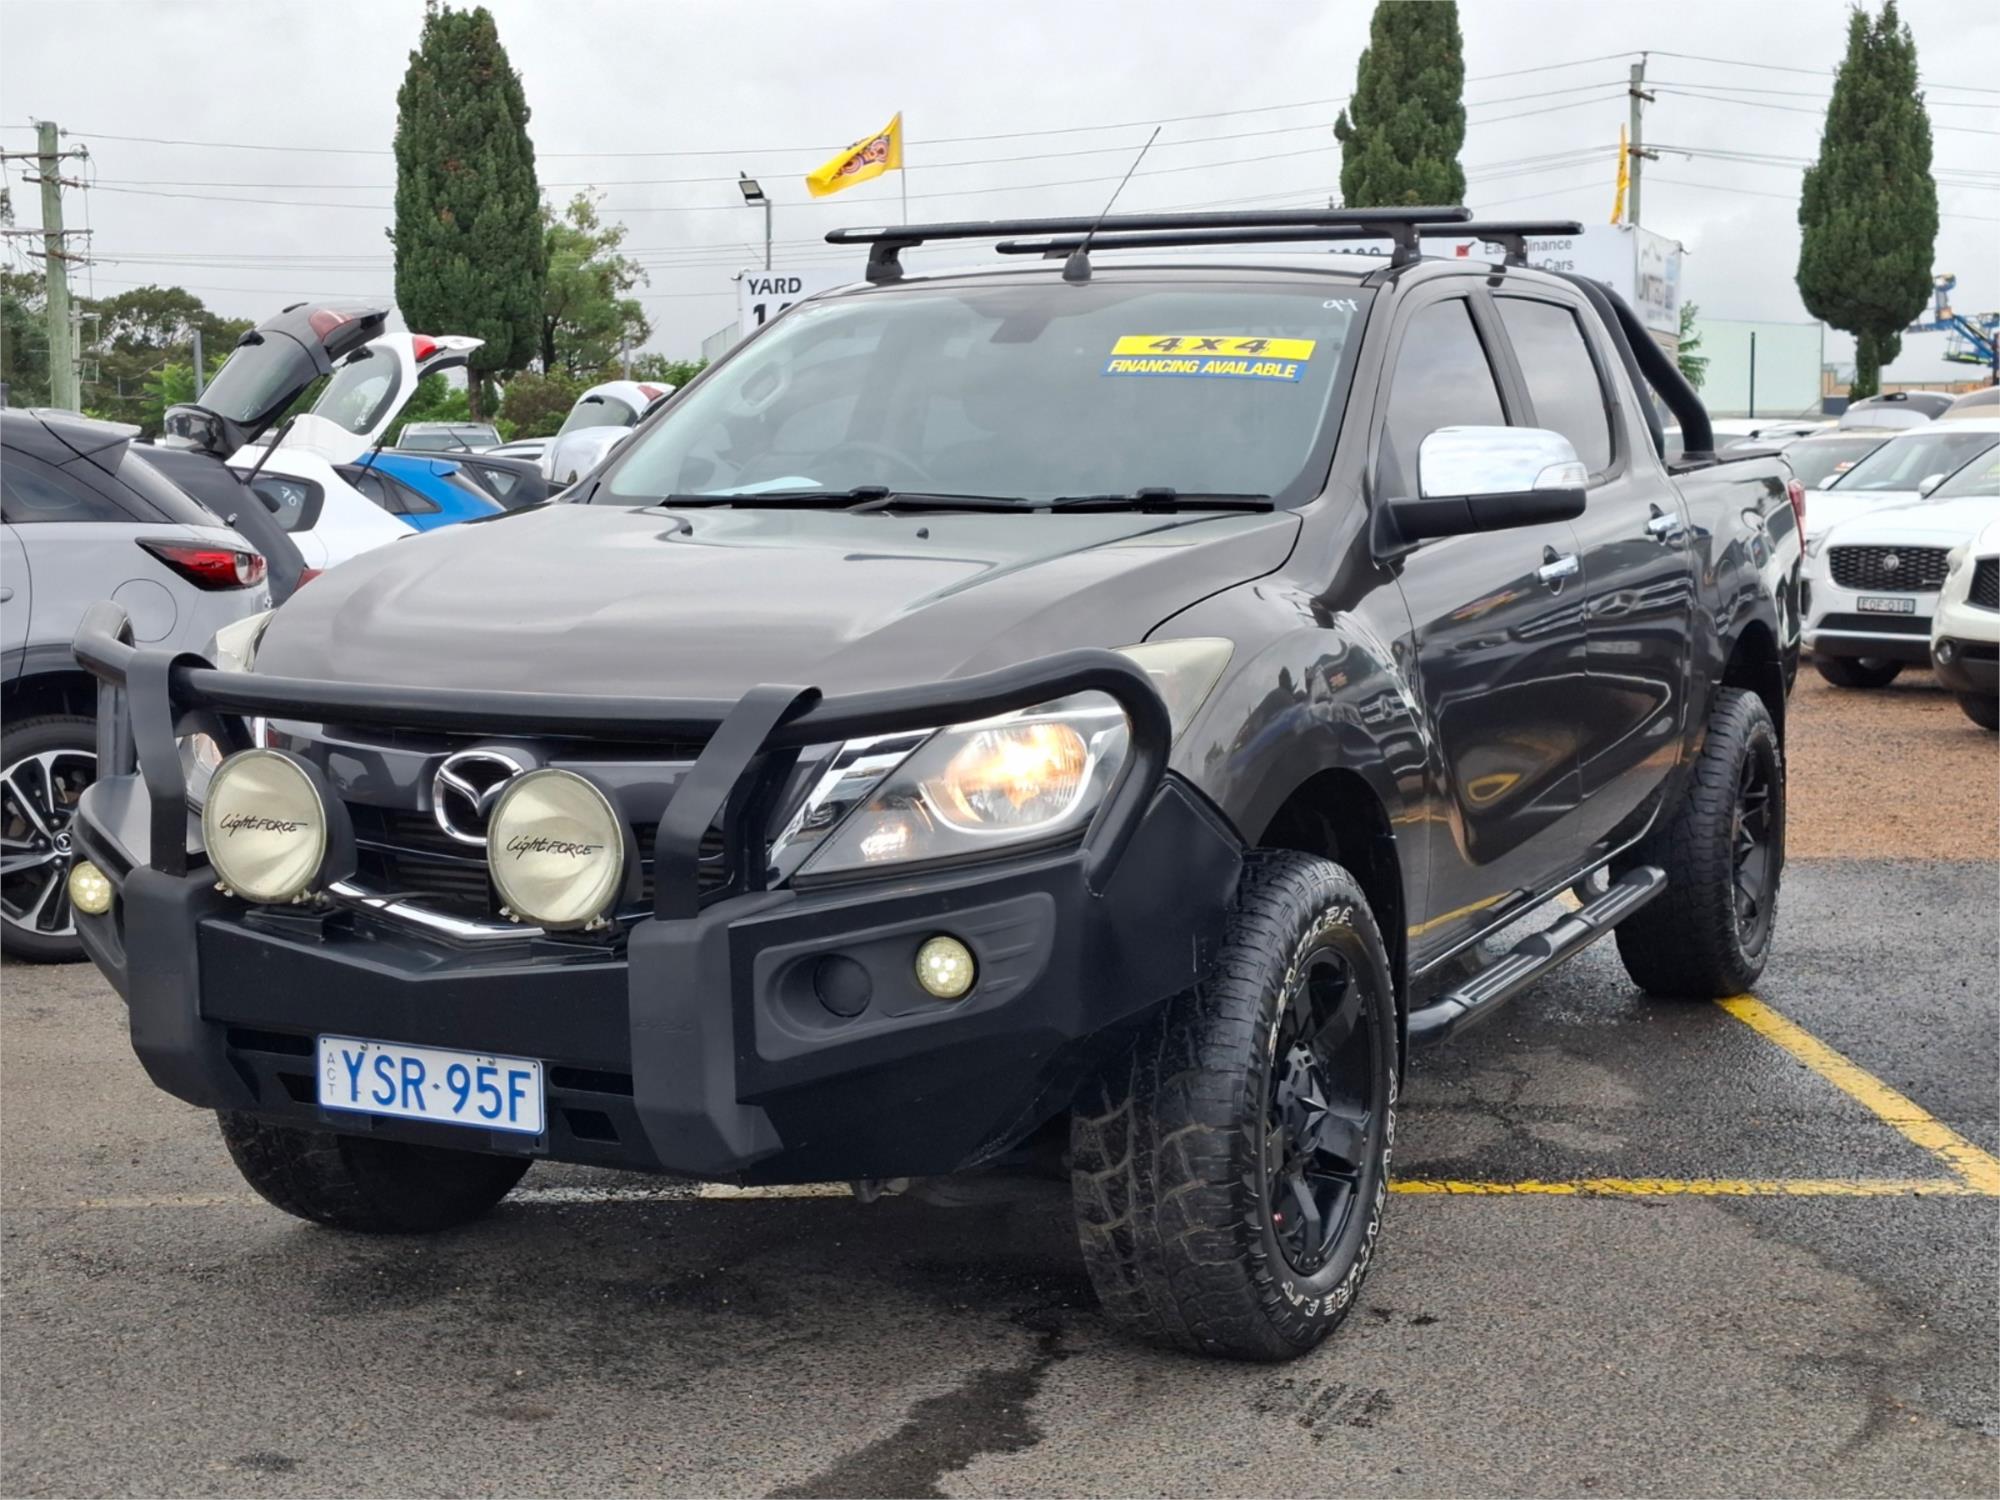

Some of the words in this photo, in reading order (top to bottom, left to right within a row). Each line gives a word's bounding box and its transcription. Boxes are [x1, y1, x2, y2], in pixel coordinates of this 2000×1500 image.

[1527, 239, 1573, 252] inance
[1544, 258, 1574, 271] Cars
[747, 277, 802, 295] YARD
[1107, 359, 1200, 373] FINANCING
[1200, 361, 1298, 378] AVAILABLE
